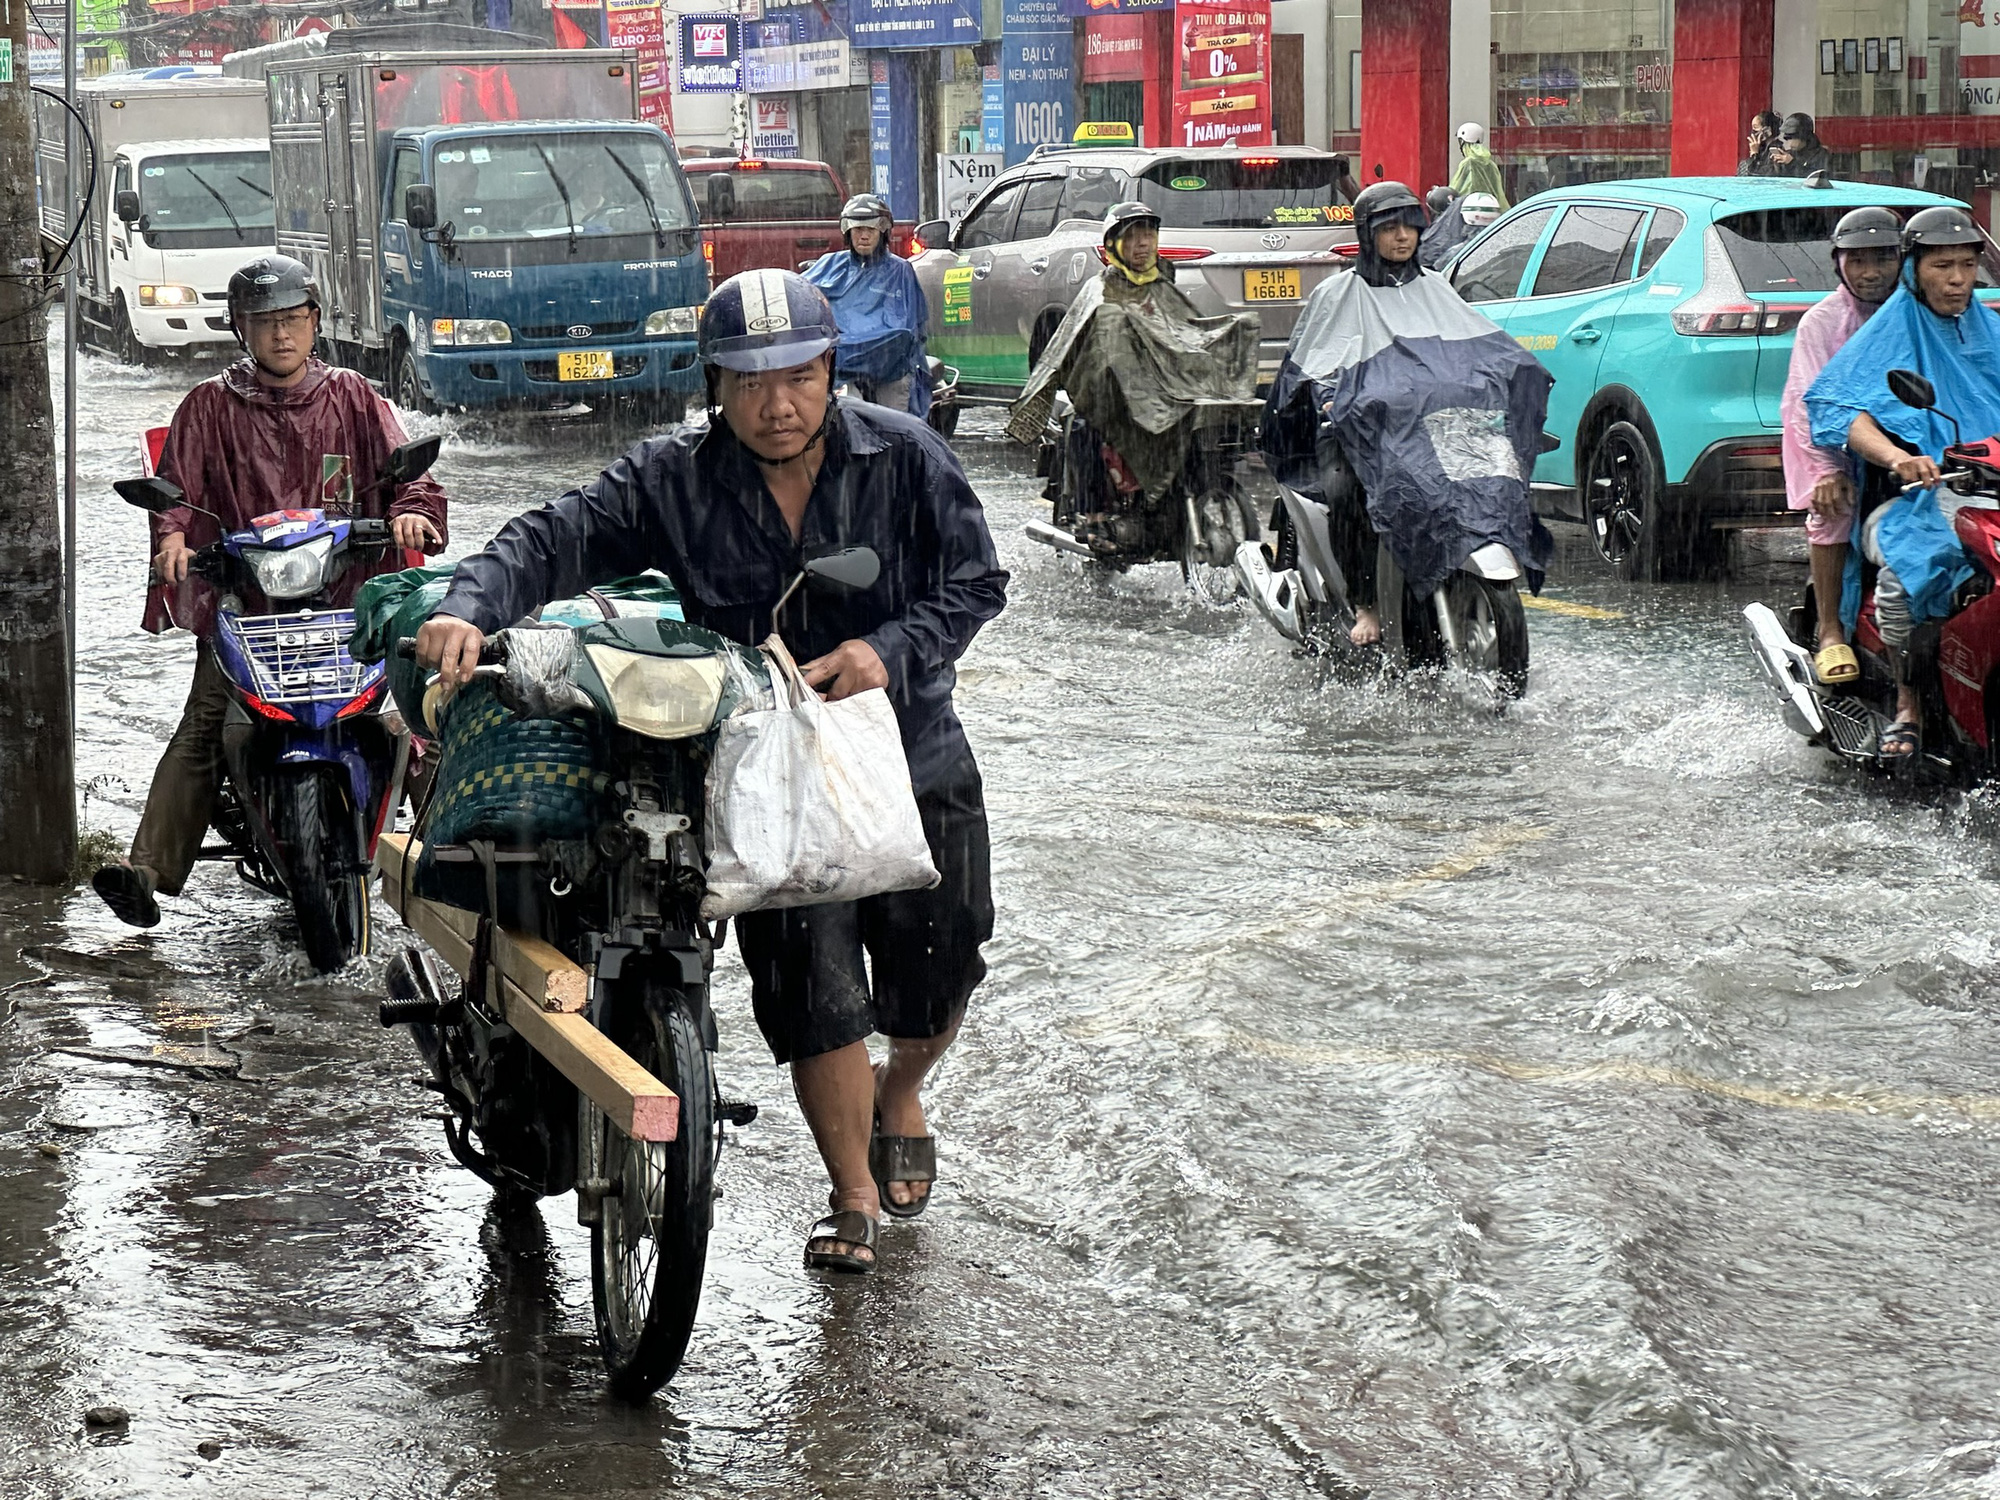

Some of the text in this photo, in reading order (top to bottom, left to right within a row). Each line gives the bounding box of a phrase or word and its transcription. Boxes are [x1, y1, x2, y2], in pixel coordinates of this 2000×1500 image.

[1195, 13, 1213, 26] TIVI
[1229, 12, 1245, 26] ĐÃI
[1247, 11, 1266, 26] LỚN
[695, 26, 724, 40] VTEC
[611, 34, 645, 47] EURO
[1087, 33, 1101, 55] 186
[178, 50, 194, 58] MUA
[1022, 44, 1055, 65] ĐẠI LÝ
[1209, 49, 1237, 77] 0%
[683, 64, 738, 86] viettien
[1211, 101, 1234, 112] TẶNG
[755, 133, 794, 147] viettien
[1183, 121, 1194, 147] 1
[1194, 122, 1226, 142] NĂM
[948, 159, 996, 183] Nệm
[1322, 206, 1355, 222] 105
[623, 260, 678, 271] FRONTIER
[471, 269, 513, 279] THACO
[1261, 271, 1285, 284] 51H
[1253, 285, 1296, 299] 166.83
[571, 328, 590, 336] KIA
[574, 353, 598, 366] 51D
[567, 366, 606, 379] 162.2
